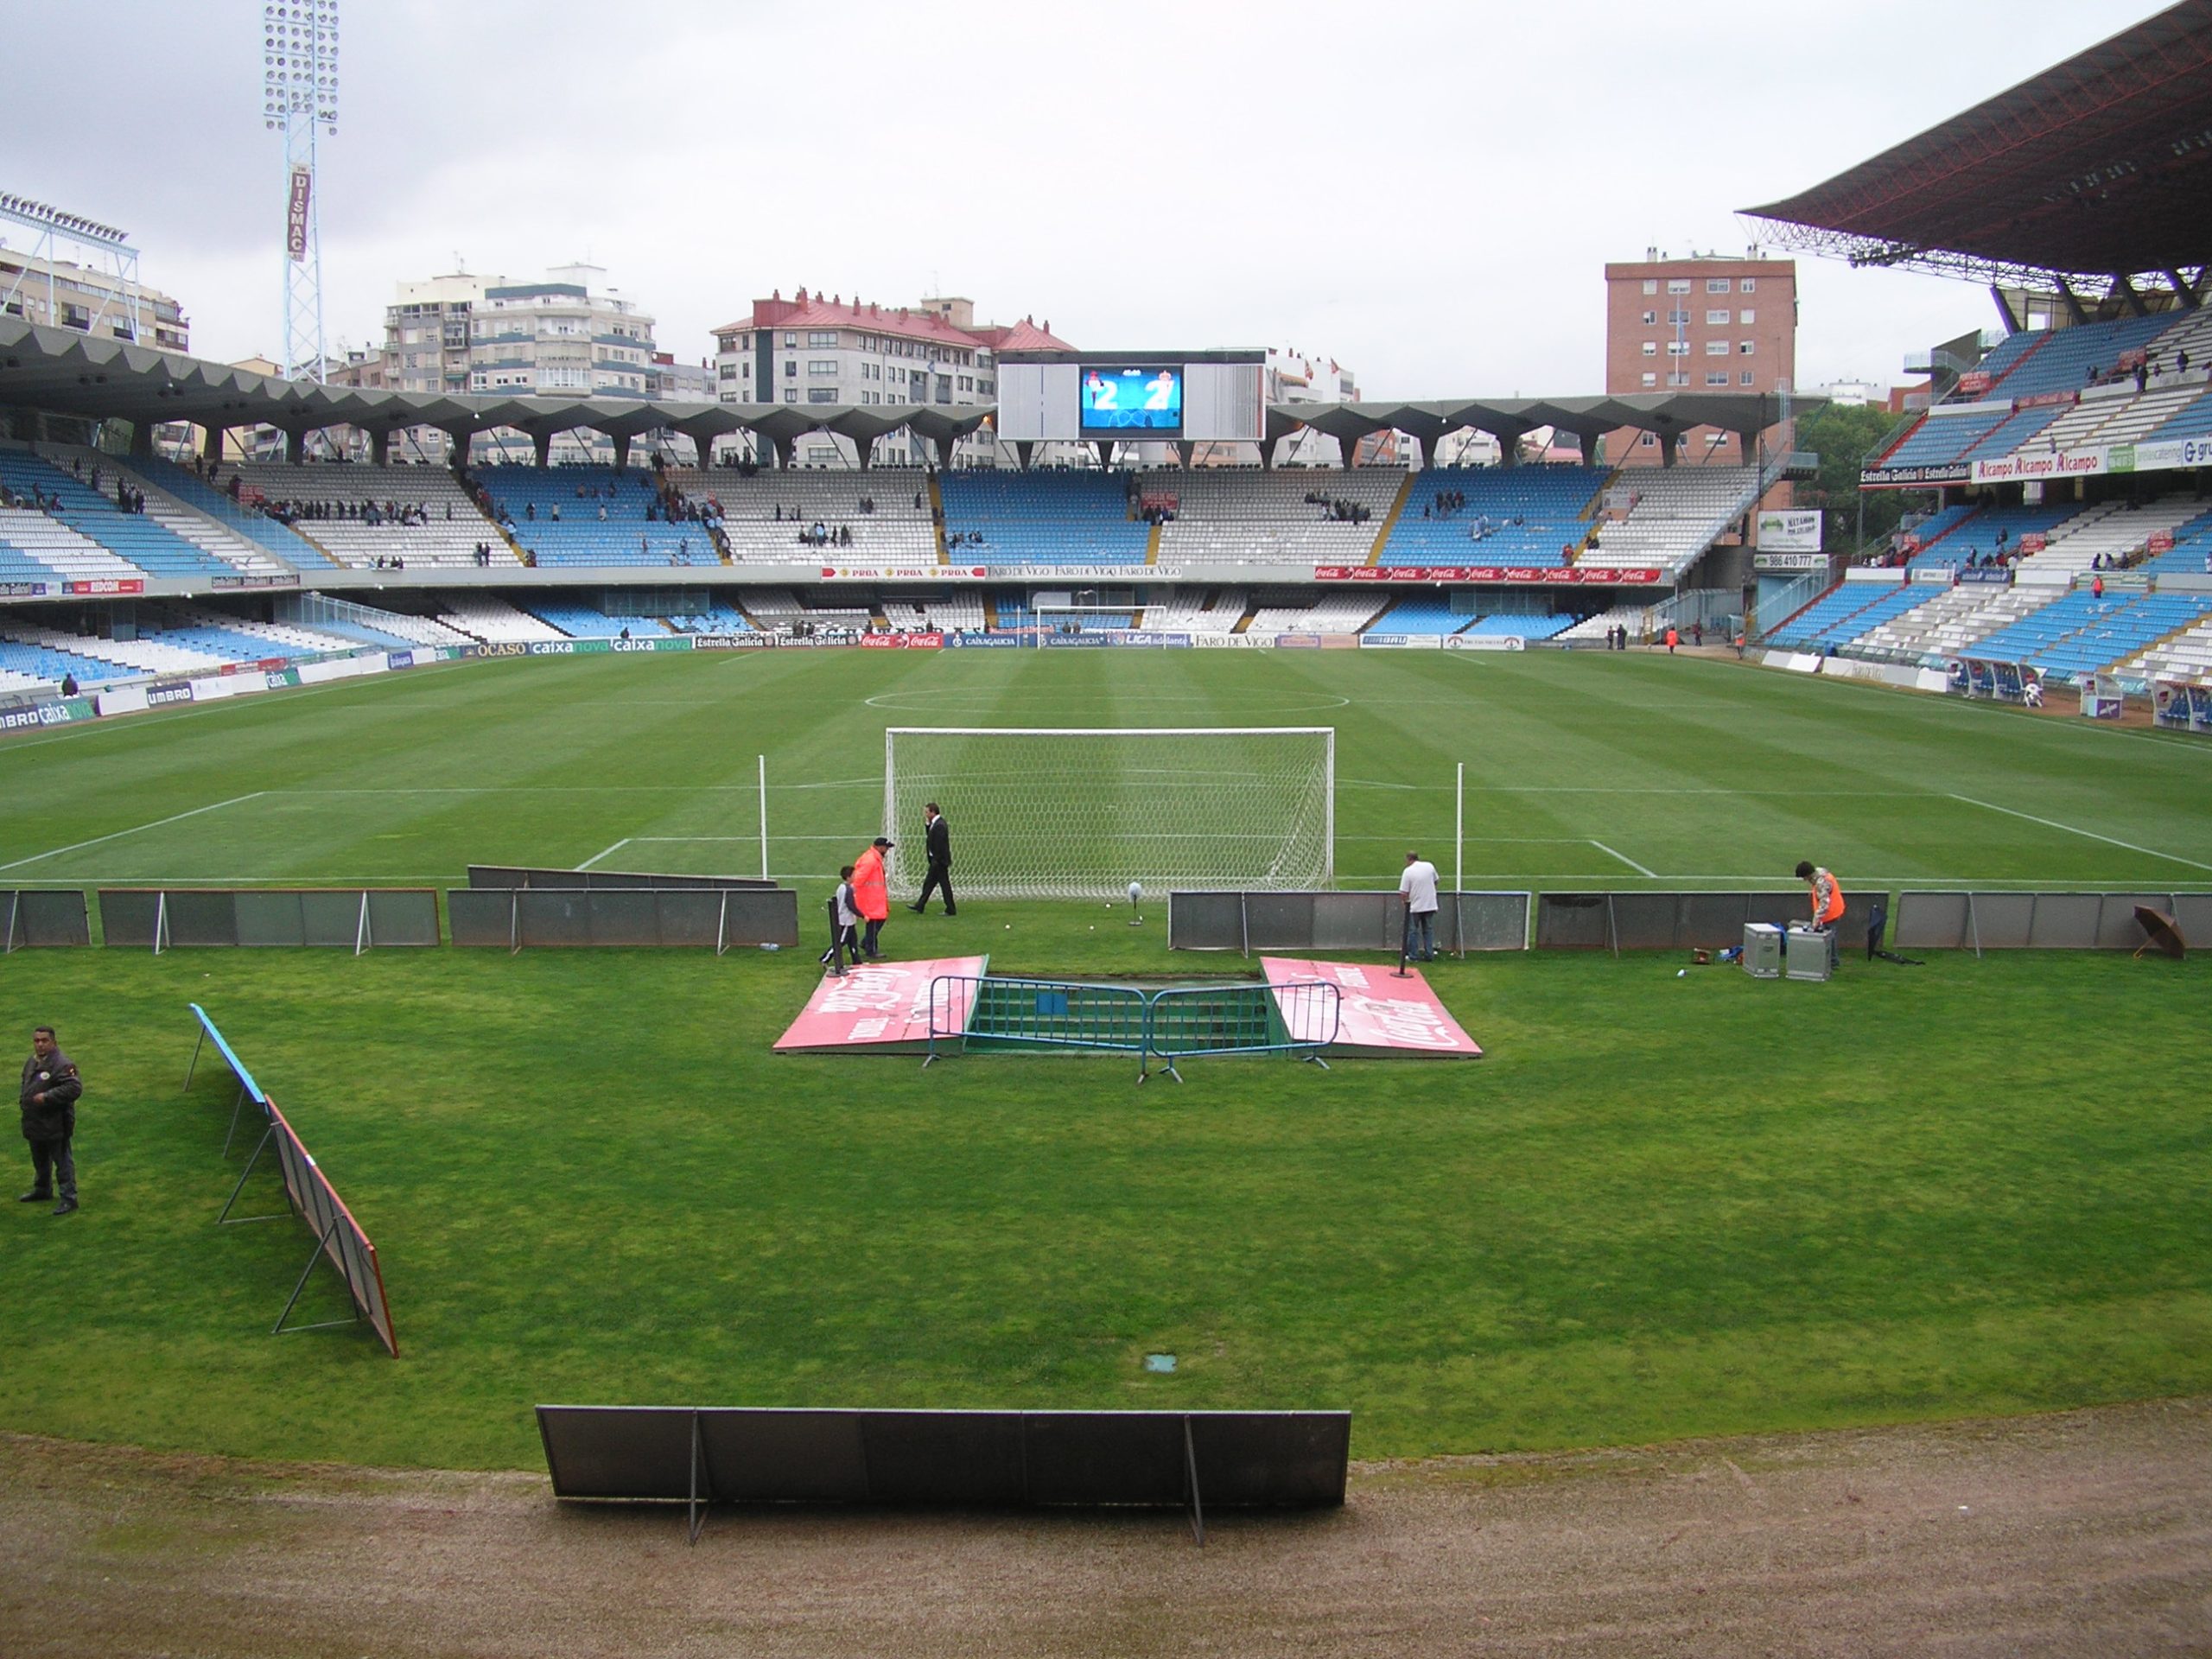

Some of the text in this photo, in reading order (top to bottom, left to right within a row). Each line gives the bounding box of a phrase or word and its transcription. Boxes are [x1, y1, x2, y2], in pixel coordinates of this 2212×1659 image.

[291, 175, 308, 251] DISMAC
[2015, 457, 2053, 476] Alcampo
[2056, 453, 2097, 473] Alcampo
[1860, 470, 1891, 482] Estrella
[1979, 461, 2012, 479] Alcampo
[1770, 556, 1812, 566] 986 410 777
[988, 566, 1049, 576] FARO DE VIGO
[1120, 566, 1181, 576] FARO DE VIGO
[697, 636, 764, 647] Estrella Galicia
[779, 636, 814, 647] Estrella
[1126, 635, 1152, 645] LIGA
[1196, 635, 1225, 646] FARO
[1228, 635, 1241, 646] DE
[1245, 634, 1273, 645] VIGO
[478, 644, 525, 657] OCASO
[149, 688, 191, 704] UMBRO
[0, 711, 38, 728] MBRO
